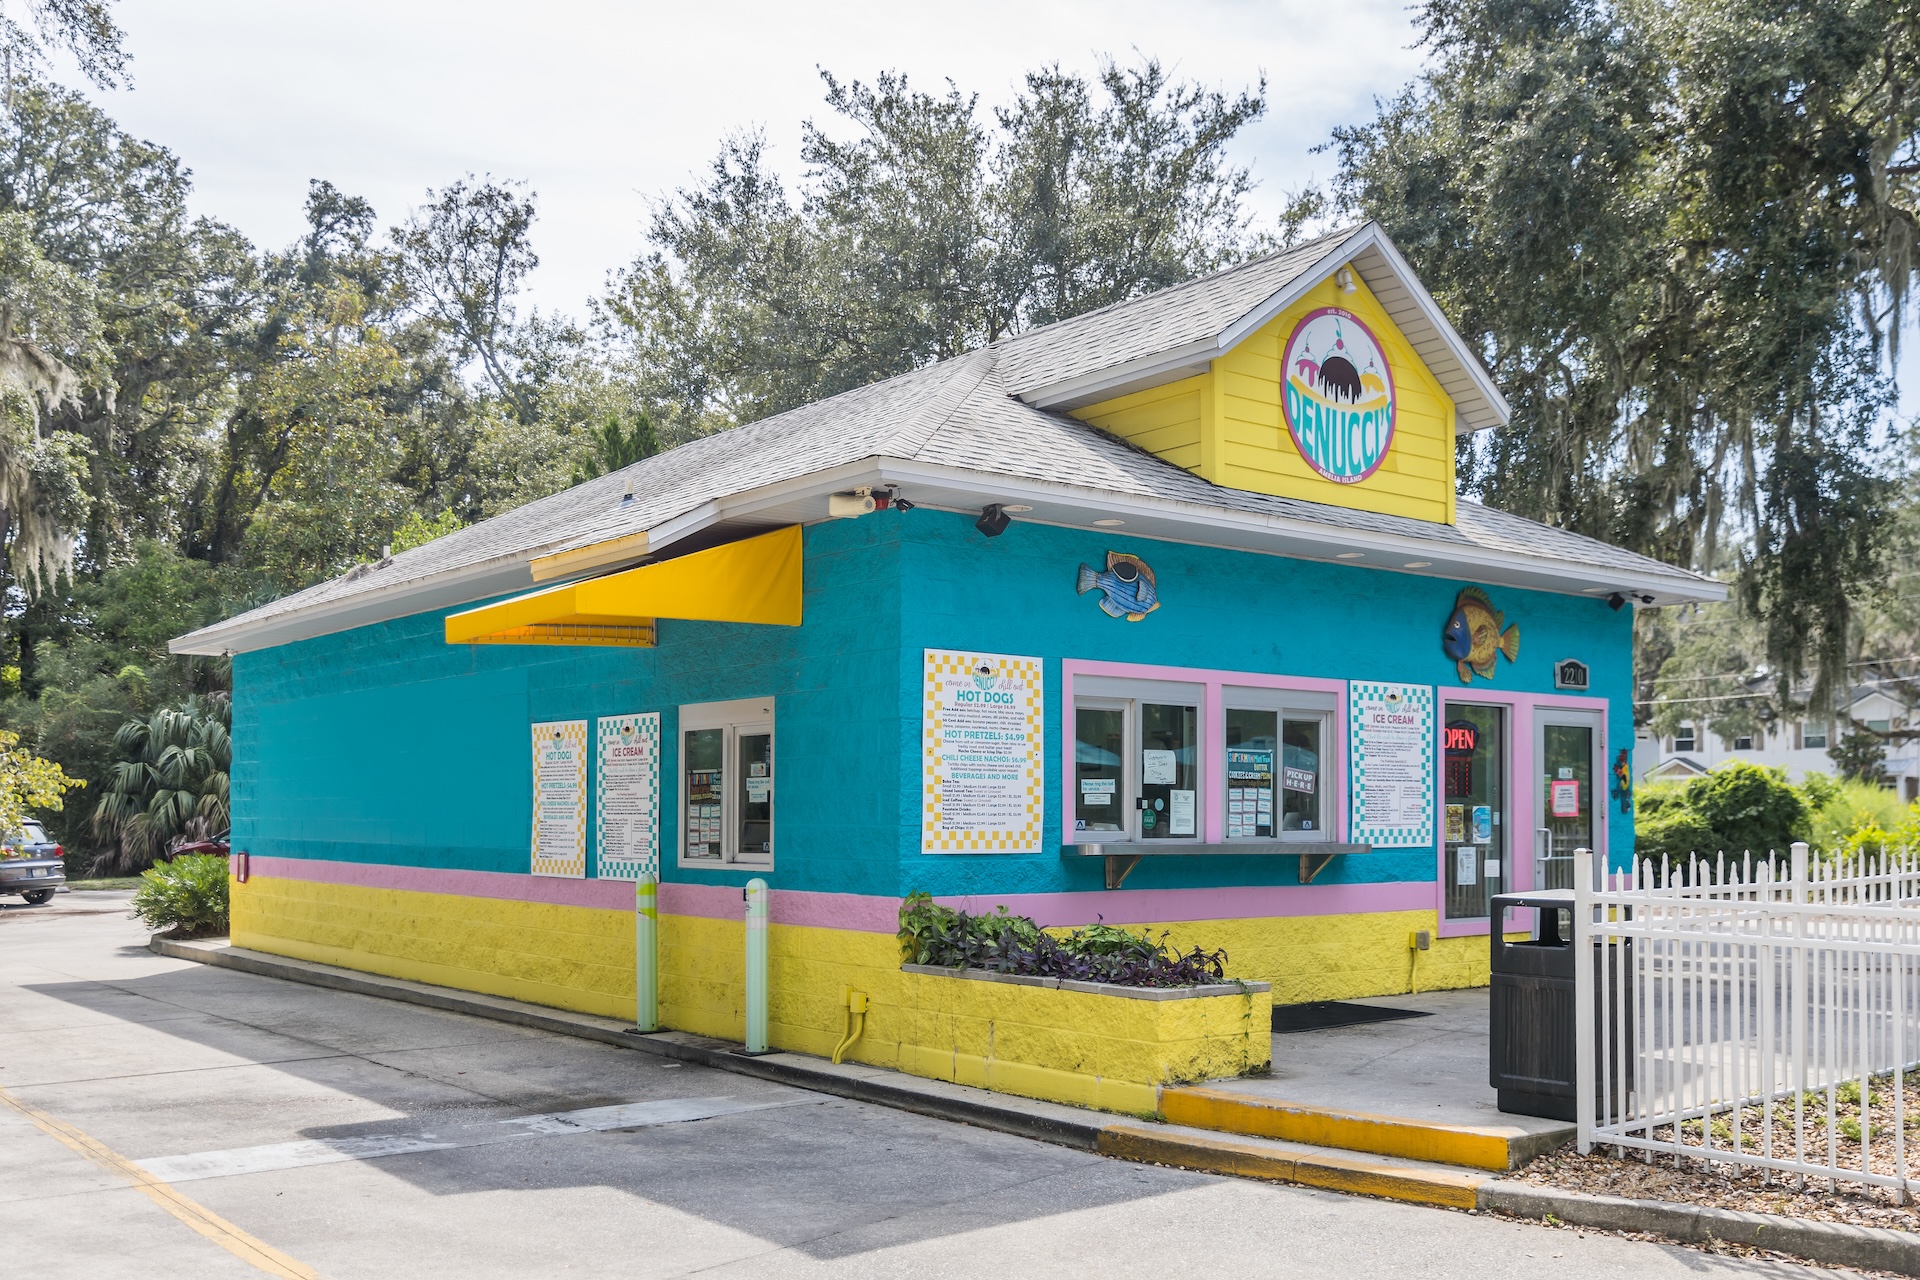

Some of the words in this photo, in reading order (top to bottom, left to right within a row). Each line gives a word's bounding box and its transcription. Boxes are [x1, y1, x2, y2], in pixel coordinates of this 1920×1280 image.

[1338, 310, 1352, 319] 2010
[1286, 379, 1392, 476] DENUCCI'S
[1319, 468, 1341, 482] AMELIA
[1342, 475, 1362, 483] ISLAND
[1564, 668, 1583, 684] 2210
[999, 679, 1013, 691] chill
[1014, 680, 1024, 690] out
[957, 690, 981, 702] HOT
[984, 692, 1014, 704] DOGS
[1373, 714, 1385, 723] ICE
[1388, 715, 1414, 724] CREAM
[945, 730, 962, 739] HOT
[964, 731, 1003, 740] PRETZELS:
[1005, 733, 1025, 741] $4.99
[1444, 728, 1475, 750] OPEN
[546, 752, 556, 761] HOT
[558, 751, 572, 760] DOGS
[613, 747, 621, 757] ICE
[623, 747, 644, 757] CREAM
[1287, 770, 1303, 780] PICK
[1304, 774, 1313, 782] UP
